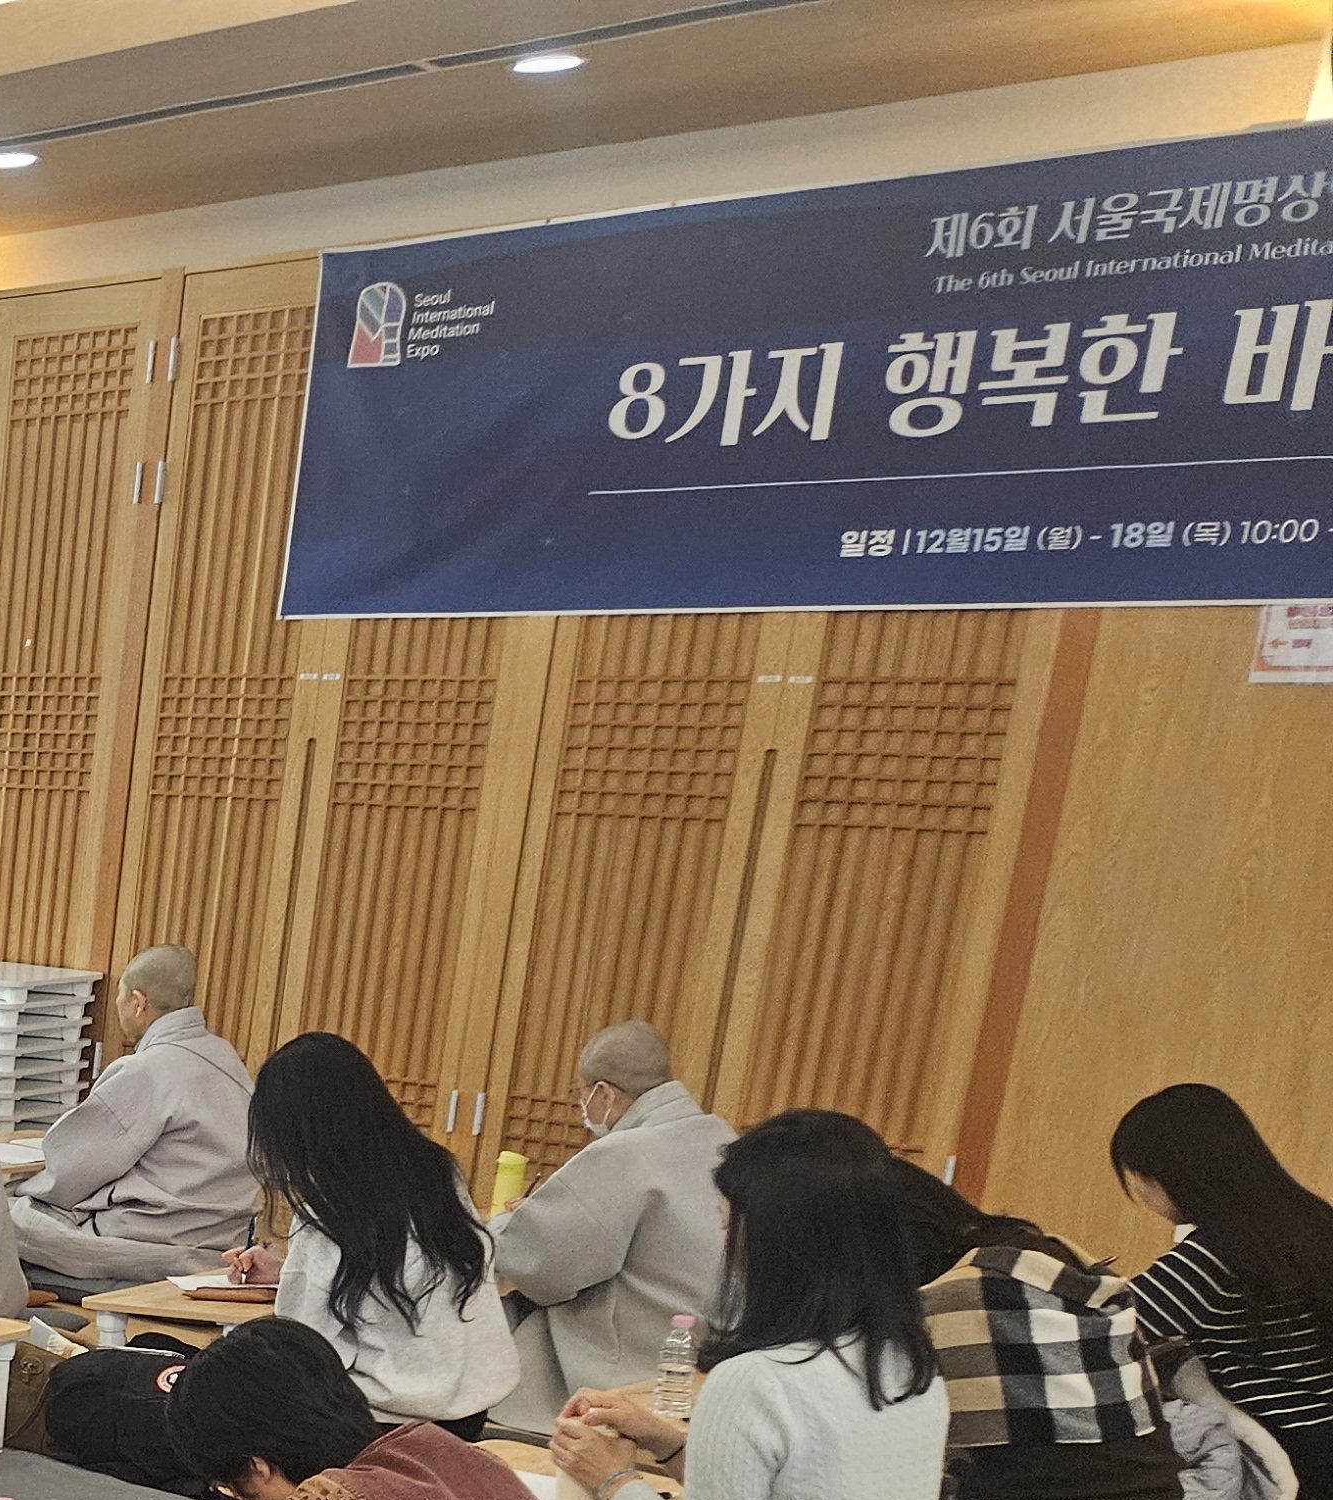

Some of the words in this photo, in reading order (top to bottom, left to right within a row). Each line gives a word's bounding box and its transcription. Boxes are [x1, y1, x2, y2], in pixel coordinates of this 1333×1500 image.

[925, 205, 1038, 258] 제6회
[1048, 171, 1333, 243] 서울국제명상
[934, 275, 973, 294] The
[978, 264, 1013, 289] 6th
[1020, 260, 1079, 285] Seoul
[1085, 244, 1242, 278] International
[411, 301, 496, 325] International
[413, 289, 453, 308] Seoul
[407, 322, 481, 341] Meditation
[406, 344, 440, 360] Expo
[607, 341, 844, 447] 8가지
[885, 311, 1183, 437] 행복한
[839, 529, 896, 557] 일정
[915, 525, 1031, 555] 12월15일
[1036, 524, 1083, 551] (월)
[1109, 521, 1176, 548] 18일
[1182, 519, 1231, 547] (목)
[1239, 518, 1319, 544] 10:00
